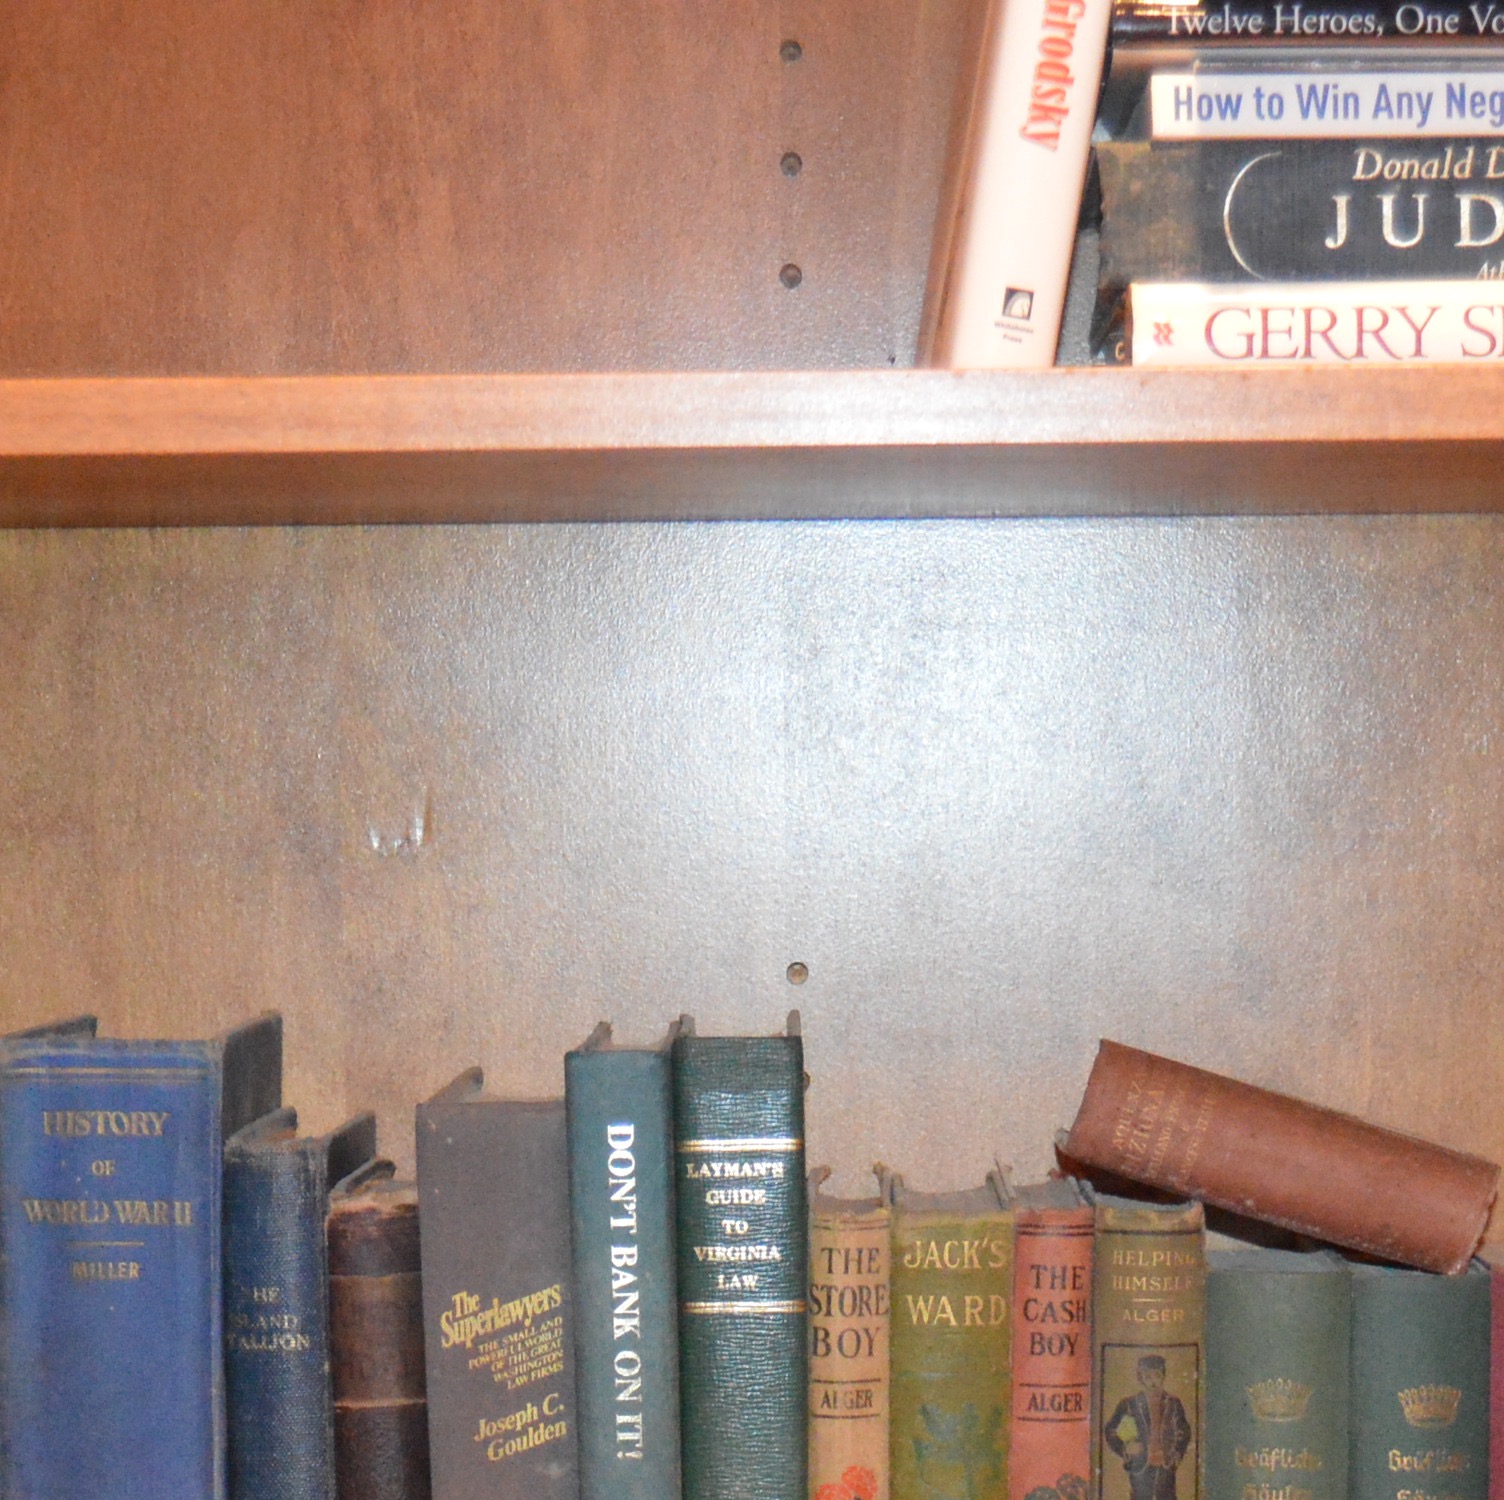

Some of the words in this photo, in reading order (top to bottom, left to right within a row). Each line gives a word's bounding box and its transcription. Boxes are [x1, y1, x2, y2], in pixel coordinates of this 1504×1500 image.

[1167, 3, 1264, 36] Twelve
[1274, 4, 1384, 40] Heroes,
[1396, 3, 1460, 36] One
[1019, 0, 1086, 152] Grodsky
[1173, 85, 1243, 122] How
[1254, 86, 1284, 122] to
[1295, 83, 1361, 121] Win
[1372, 83, 1434, 128] Any
[1353, 146, 1474, 182] Donald
[1204, 304, 1442, 361] GERRY
[42, 1110, 170, 1139] HISTORY
[91, 1159, 116, 1177] OF
[607, 1124, 638, 1235] DON'T
[686, 1162, 786, 1180] LAYMAN'S
[20, 1198, 110, 1226] WORLD
[113, 1199, 170, 1226] WAR
[173, 1201, 194, 1227] II
[705, 1189, 767, 1206] GUIDE
[722, 1219, 749, 1235] TO
[693, 1245, 783, 1263] VIRGINIA
[821, 1246, 882, 1276] THE
[903, 1236, 1009, 1270] JACK'S
[1111, 1249, 1198, 1267] HELPING
[71, 1262, 141, 1281] MILLER
[717, 1273, 759, 1290] LAW
[1030, 1264, 1086, 1291] THE
[451, 1290, 481, 1319] The
[611, 1245, 642, 1340] BANK
[809, 1283, 890, 1318] STORE
[439, 1284, 563, 1349] Superlawyers
[906, 1294, 1009, 1329] WARD
[1023, 1298, 1088, 1325] CASH
[1123, 1308, 1186, 1323] ALGER
[468, 1343, 523, 1371] POWERFUL
[523, 1328, 563, 1347] WORLD
[478, 1339, 500, 1353] THE
[502, 1328, 539, 1345] SMALL
[540, 1316, 563, 1332] AND
[811, 1326, 882, 1360] BOY
[1028, 1331, 1081, 1358] BOY
[491, 1360, 505, 1373] OF
[508, 1351, 530, 1366] THE
[531, 1338, 562, 1358] GREAT
[493, 1350, 564, 1382] WASHINGTON
[507, 1375, 530, 1389] LAW
[531, 1360, 564, 1382] FIRMS
[614, 1352, 643, 1402] ON
[473, 1402, 540, 1442] Joseph
[542, 1393, 566, 1416] C.
[1027, 1391, 1083, 1413] ALGER
[486, 1420, 568, 1461] Goulden
[614, 1413, 644, 1461] IT!
